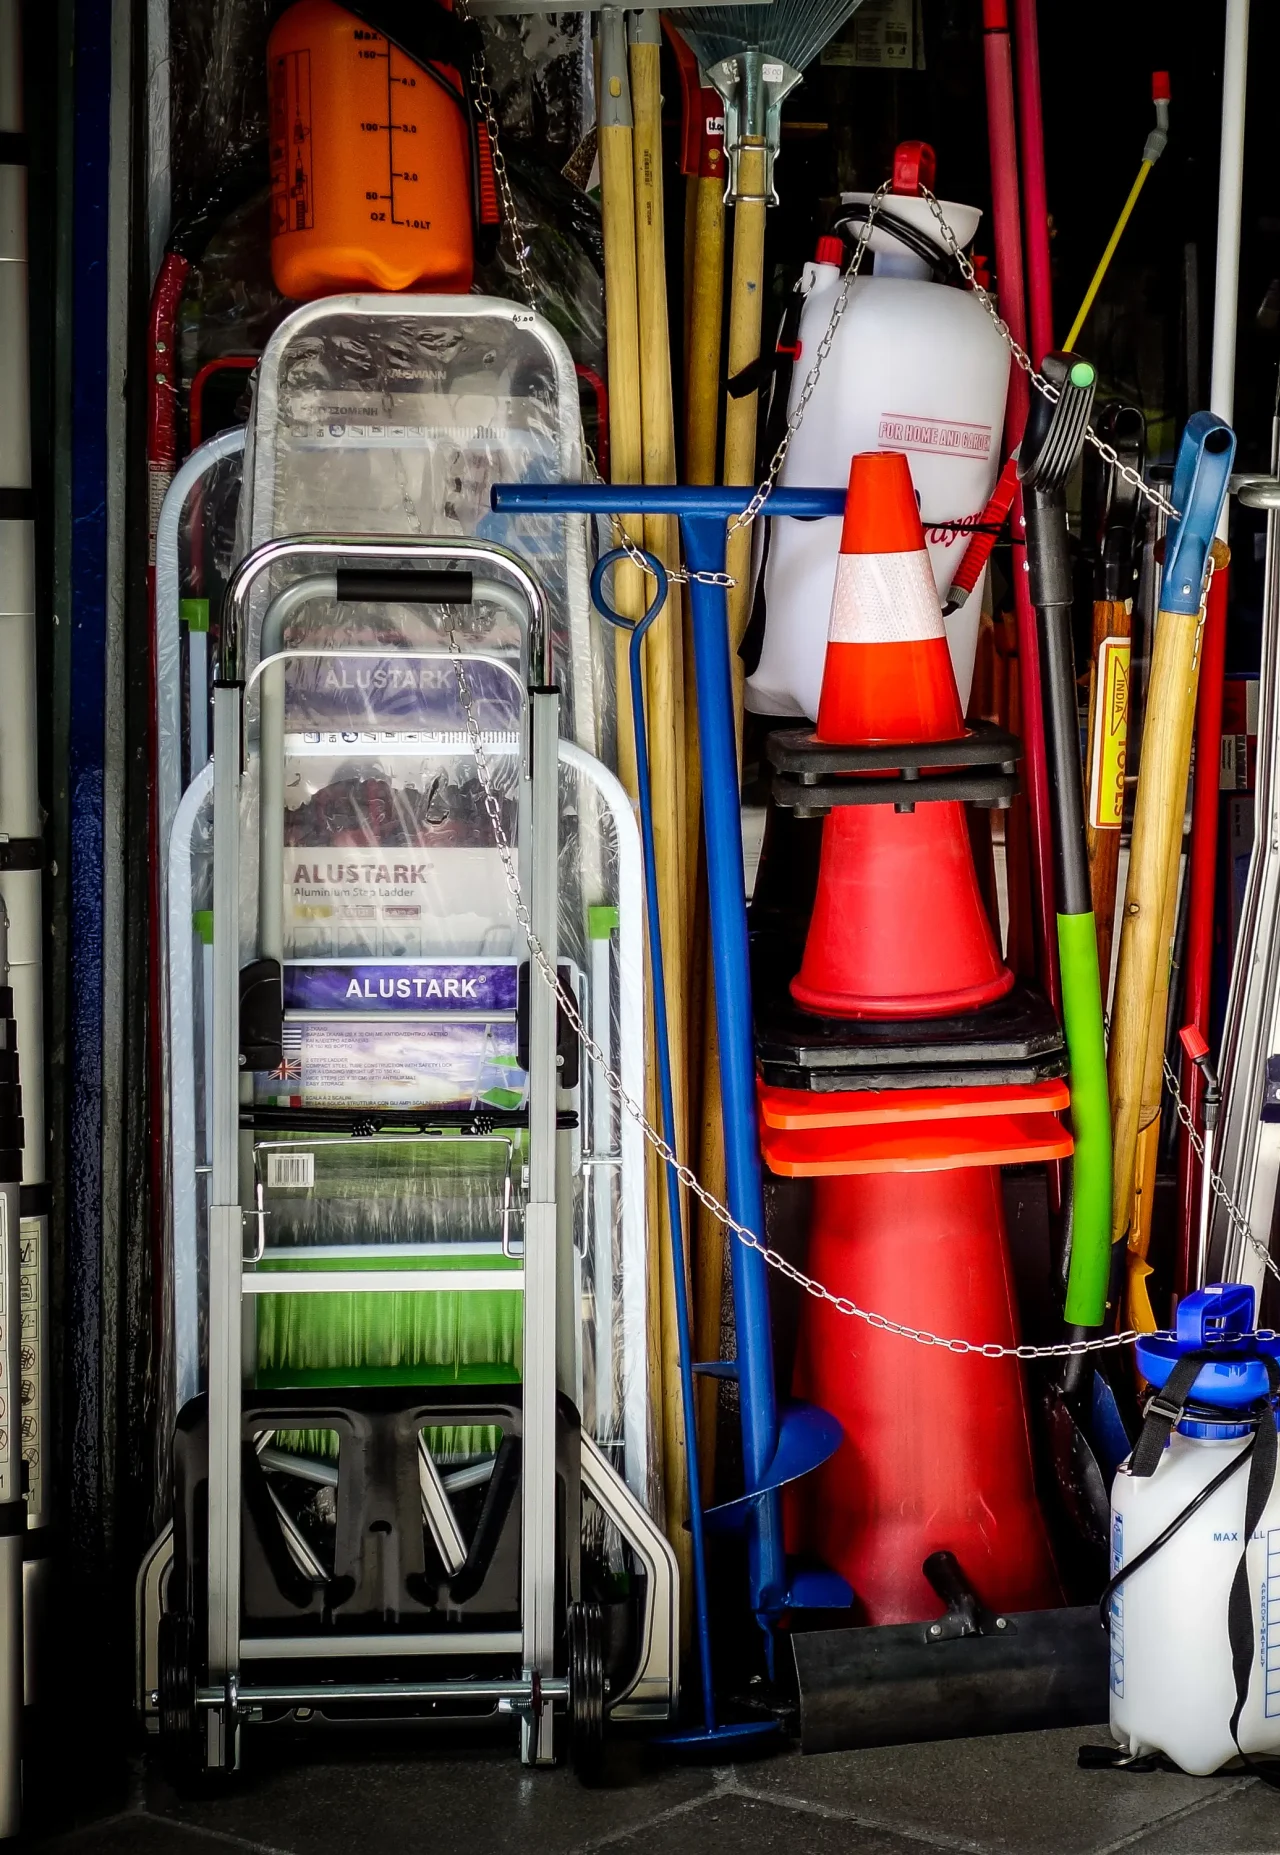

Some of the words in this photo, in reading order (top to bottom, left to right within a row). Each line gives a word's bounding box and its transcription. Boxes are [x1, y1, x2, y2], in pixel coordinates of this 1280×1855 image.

[354, 30, 381, 41] Max.
[402, 78, 416, 87] 4.0
[360, 123, 378, 132] 100
[402, 124, 417, 134] 3.0
[403, 172, 418, 182] 2.0
[366, 192, 378, 200] 50
[370, 213, 385, 221] OZ
[878, 422, 903, 440] FOR
[905, 424, 939, 445] HOME
[939, 429, 961, 448] AND
[325, 669, 453, 689] ALUSTARK
[1115, 679, 1125, 713] INDIA
[293, 864, 427, 884] ALUSTARK
[294, 888, 350, 897] Aluminium
[379, 888, 414, 897] Ladder
[345, 978, 477, 998] ALUSTARK
[1213, 1532, 1238, 1541] MAX
